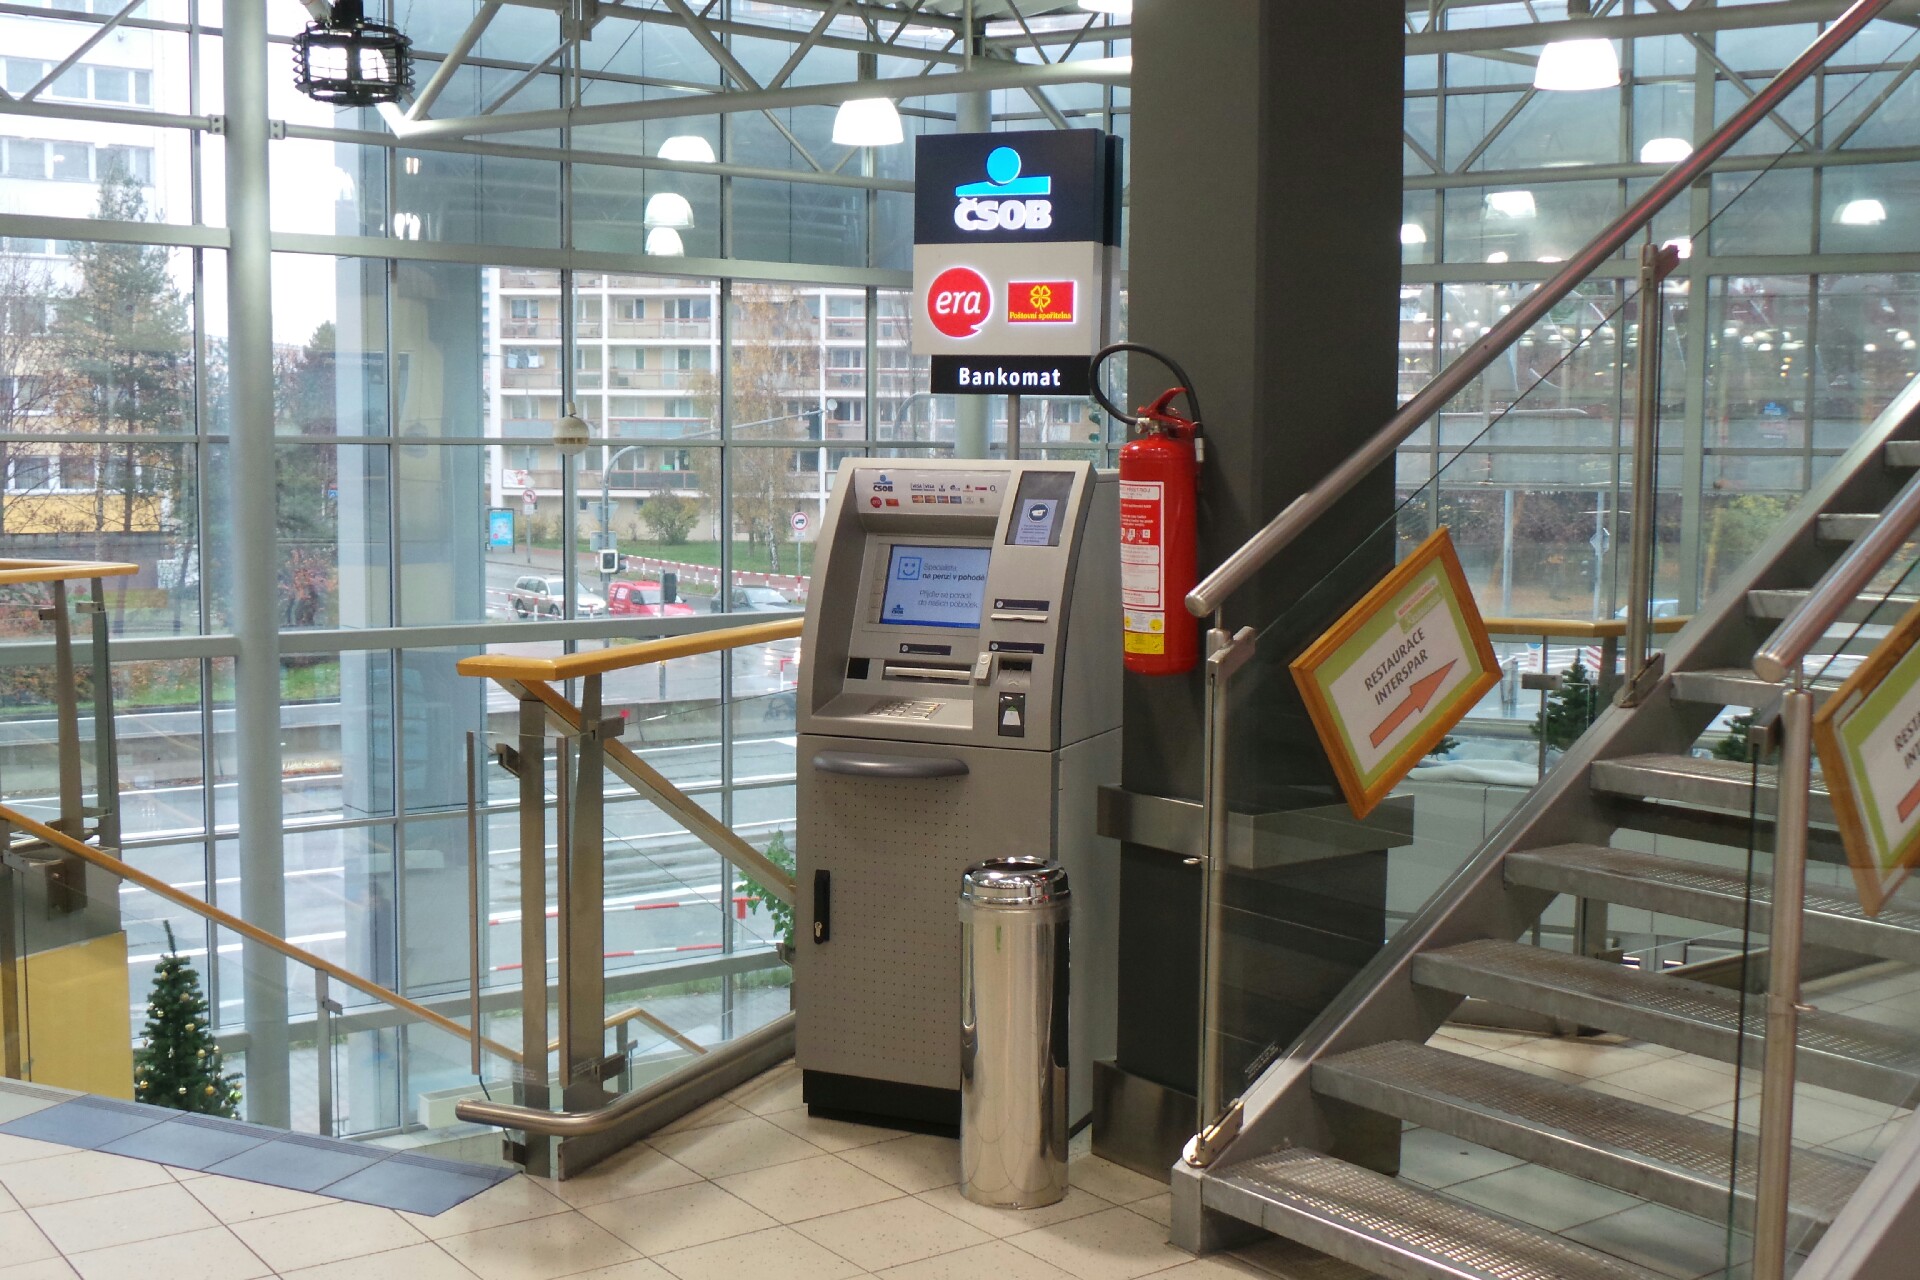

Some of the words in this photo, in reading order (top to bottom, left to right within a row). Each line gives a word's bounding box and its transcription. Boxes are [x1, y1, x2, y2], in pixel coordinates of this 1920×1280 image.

[954, 197, 1052, 230] ČSOB
[936, 291, 981, 314] era
[1009, 311, 1037, 320] Poštovní
[1037, 311, 1072, 321] spořitelna
[959, 367, 1061, 386] Bankomat
[873, 484, 893, 492] ČSOB
[1364, 627, 1426, 692] RESTAURACE
[1374, 648, 1429, 706] INTERSPAR
[1894, 712, 1920, 752] REST
